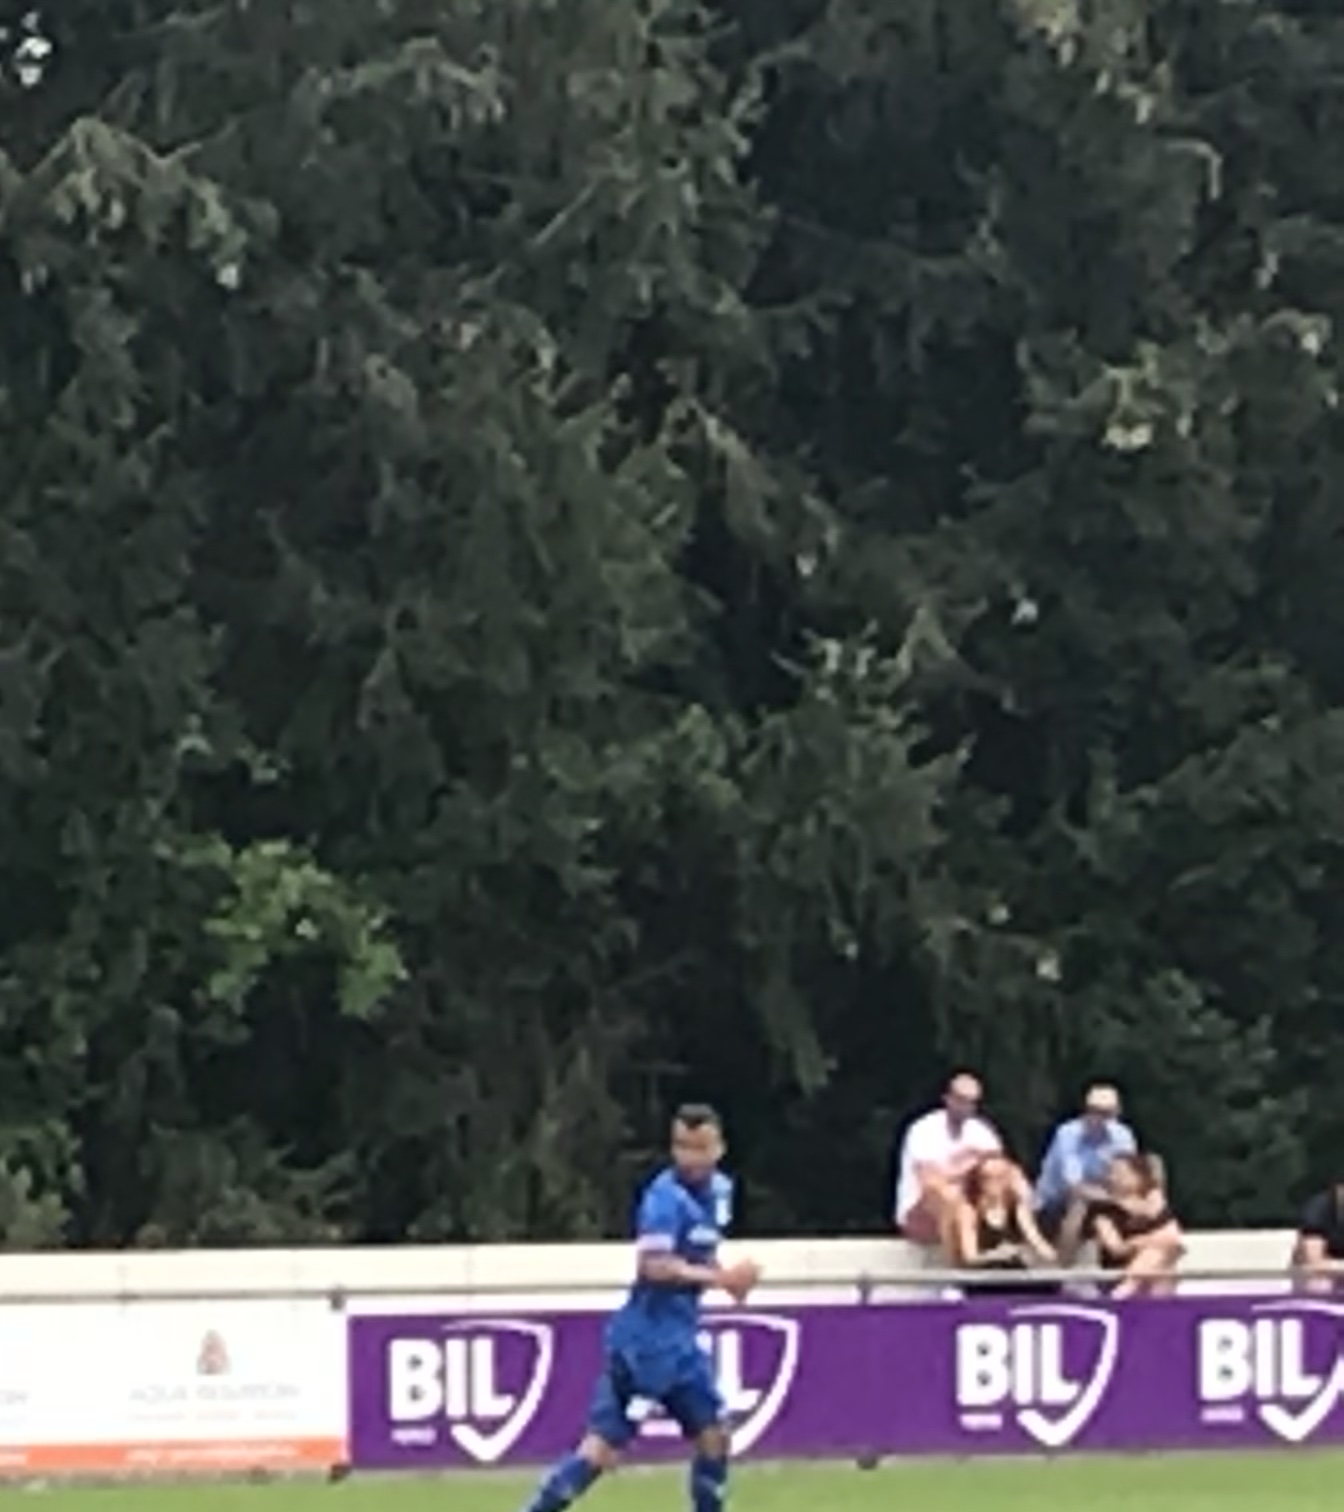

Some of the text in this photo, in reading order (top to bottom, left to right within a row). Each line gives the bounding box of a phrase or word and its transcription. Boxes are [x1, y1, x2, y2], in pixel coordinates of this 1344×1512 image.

[389, 1336, 514, 1421] BIL
[956, 1323, 1081, 1406] BIL
[1199, 1318, 1322, 1401] BIL
